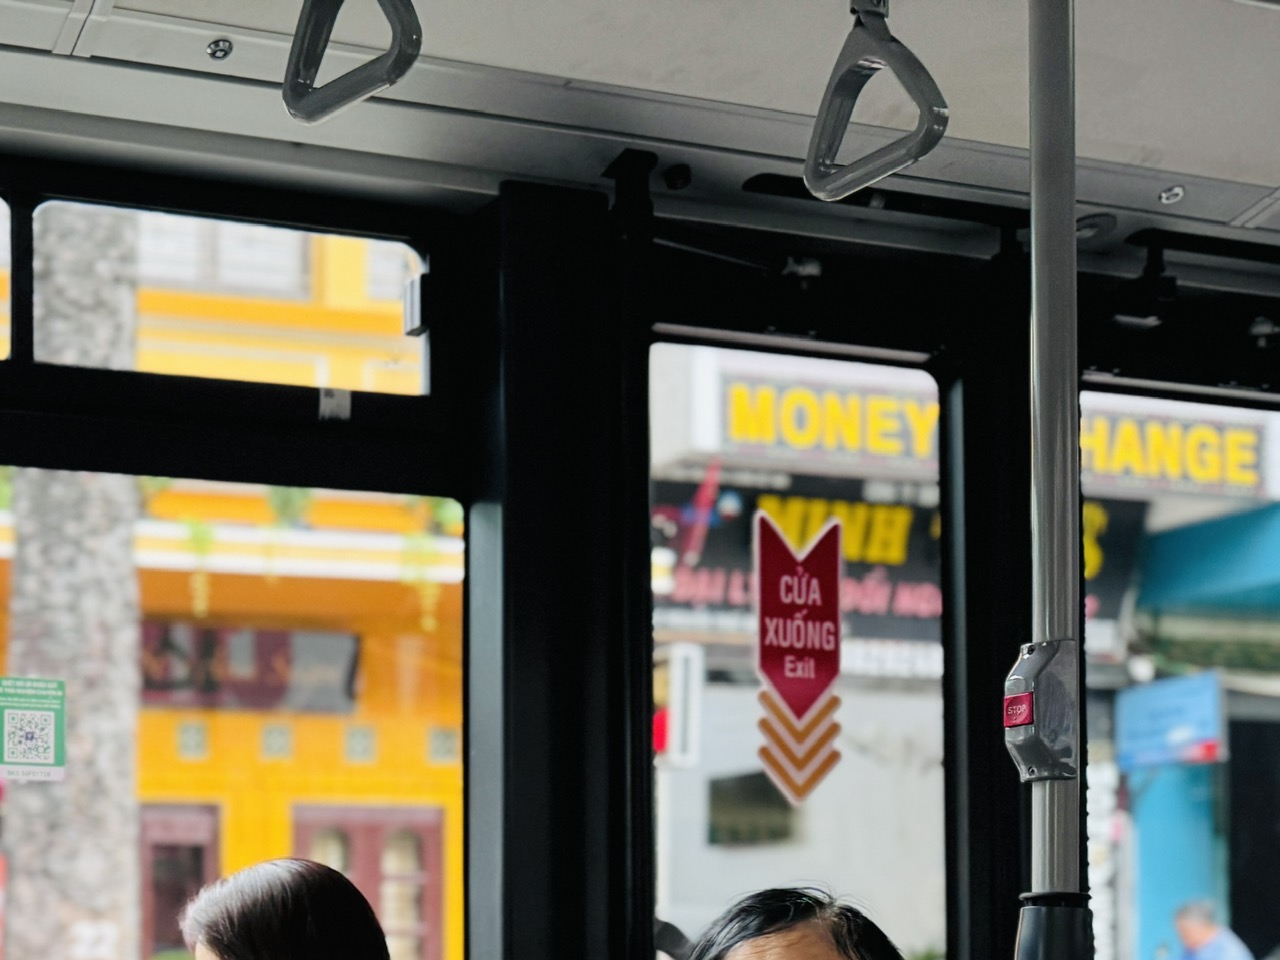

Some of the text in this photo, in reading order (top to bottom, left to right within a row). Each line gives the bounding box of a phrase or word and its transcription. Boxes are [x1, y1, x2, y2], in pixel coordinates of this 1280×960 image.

[729, 382, 1260, 487] MONEY HANGE
[779, 565, 822, 606] CỬA
[764, 608, 836, 652] XUỐNG
[784, 655, 816, 680] Exit
[1007, 704, 1027, 715] STOP
